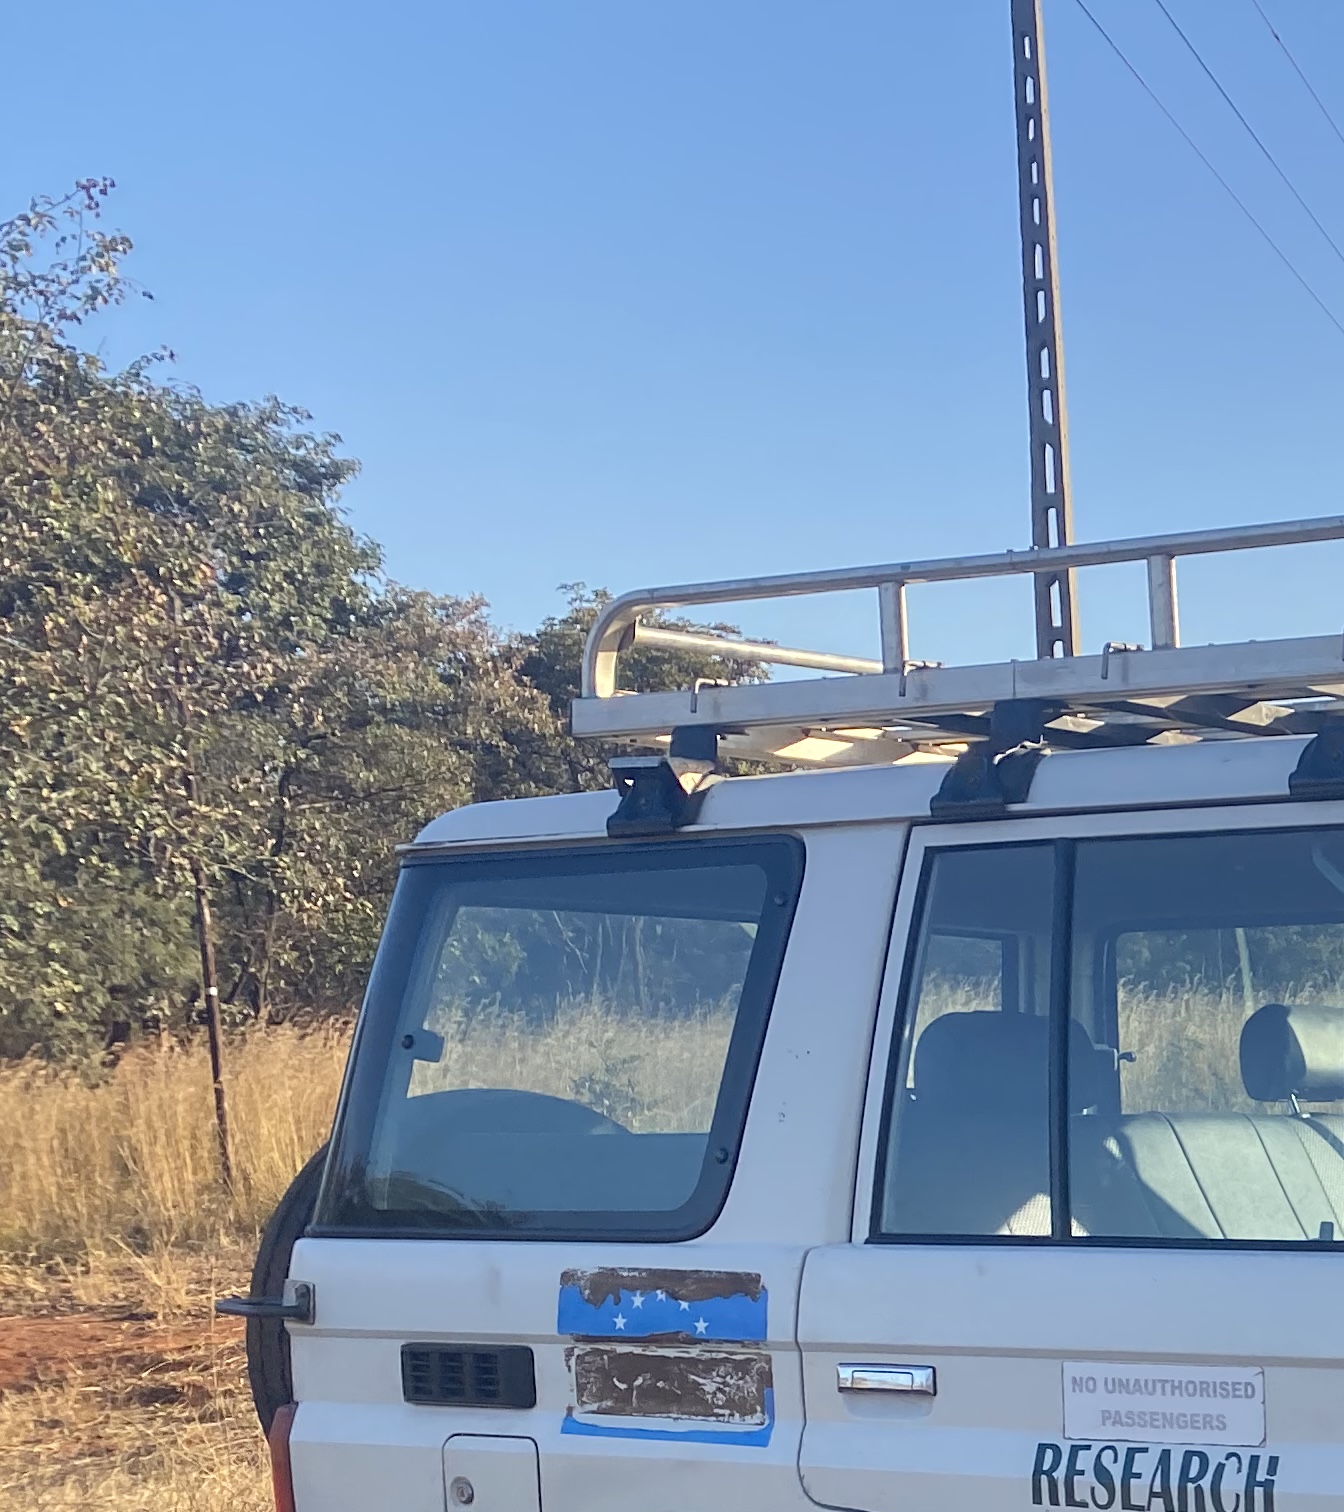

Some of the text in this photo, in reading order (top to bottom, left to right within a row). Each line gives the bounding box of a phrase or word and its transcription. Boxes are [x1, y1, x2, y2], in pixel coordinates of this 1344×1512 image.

[1071, 1375, 1256, 1400] NO UNAUTHORISED
[1100, 1409, 1227, 1431] PASSENGERS
